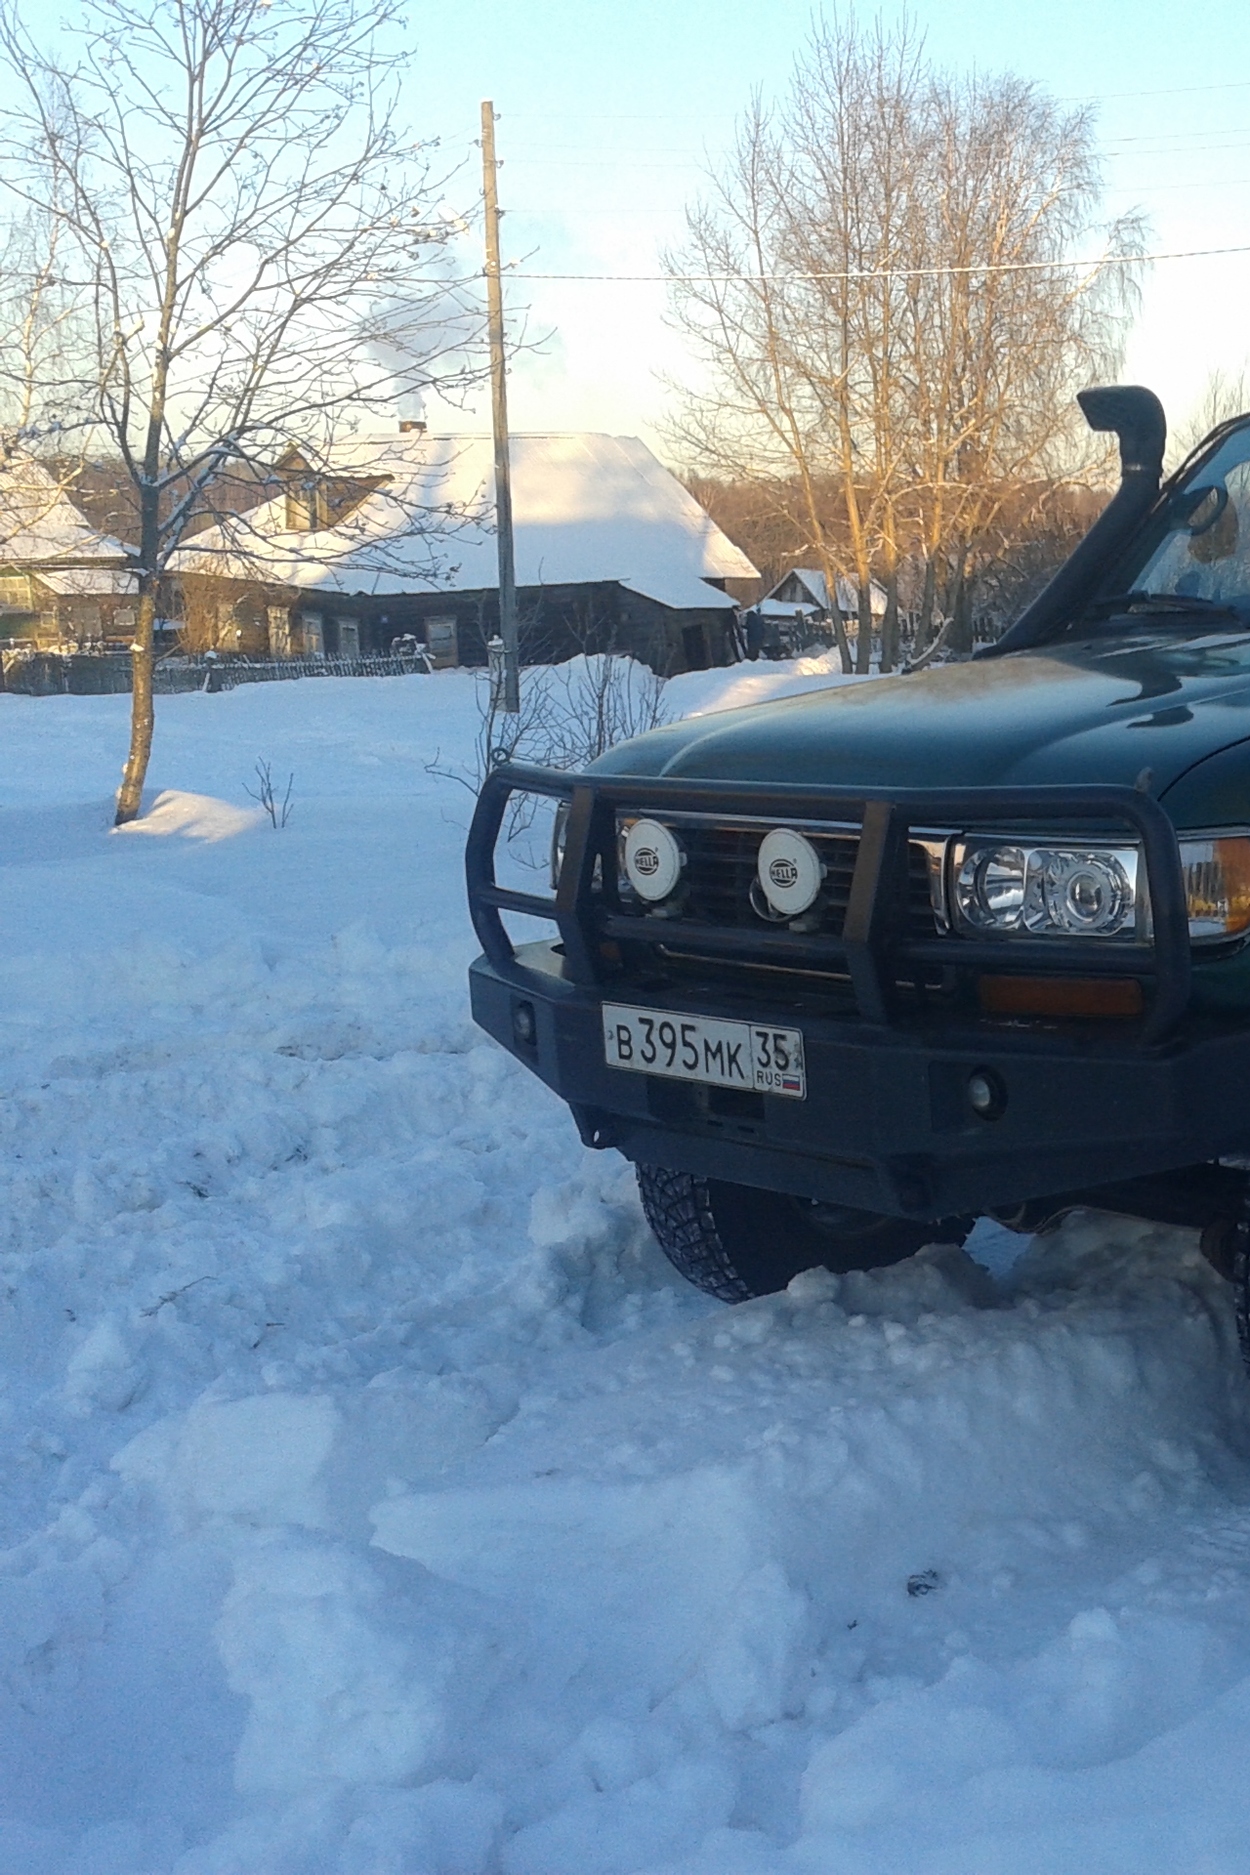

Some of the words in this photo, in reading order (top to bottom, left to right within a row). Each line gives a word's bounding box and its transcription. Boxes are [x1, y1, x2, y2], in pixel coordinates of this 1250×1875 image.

[635, 855, 659, 868] HELLA
[770, 866, 798, 879] HELLA
[755, 1031, 790, 1072] 35
[757, 1070, 782, 1087] RUS
